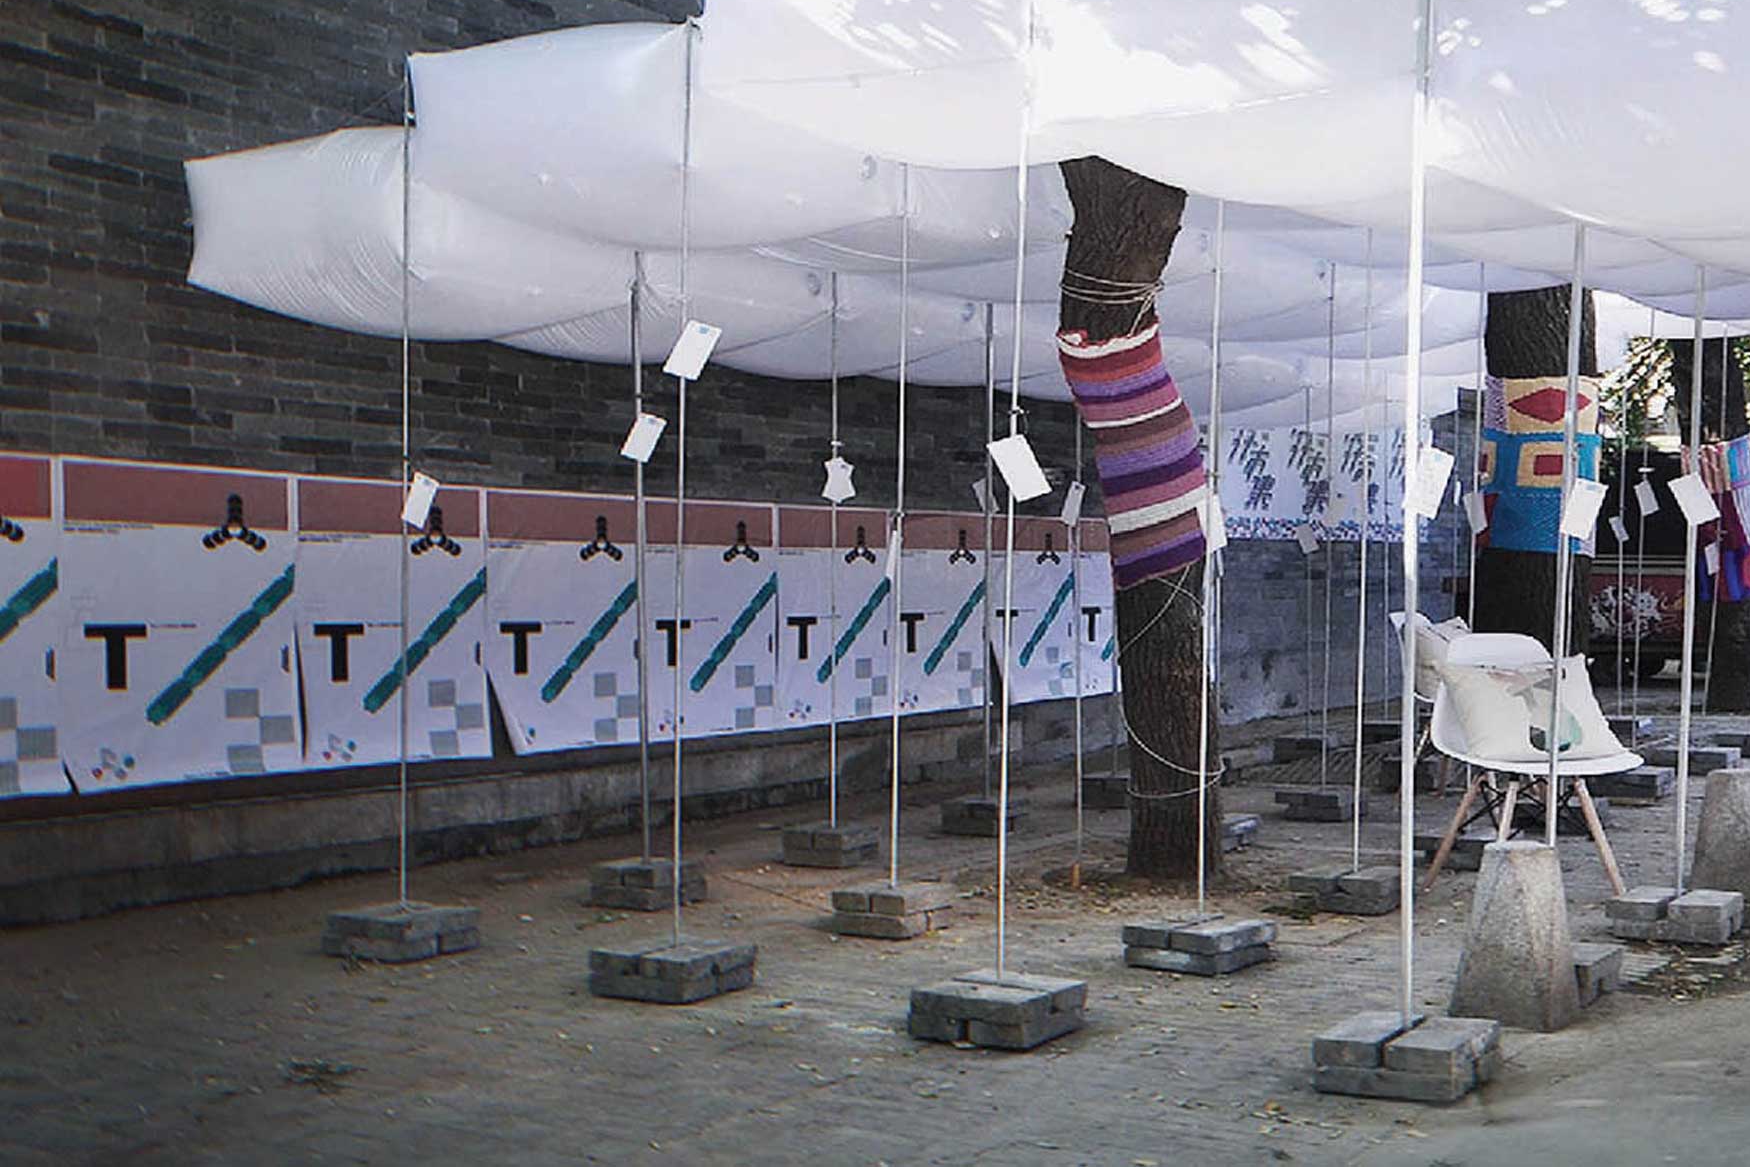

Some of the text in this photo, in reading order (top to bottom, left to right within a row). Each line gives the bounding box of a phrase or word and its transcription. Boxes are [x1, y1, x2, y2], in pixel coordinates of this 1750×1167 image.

[499, 622, 542, 674] T
[656, 619, 691, 666] T
[787, 617, 818, 660] T
[1081, 607, 1101, 641] T
[84, 624, 147, 690] T
[313, 623, 365, 682] T
